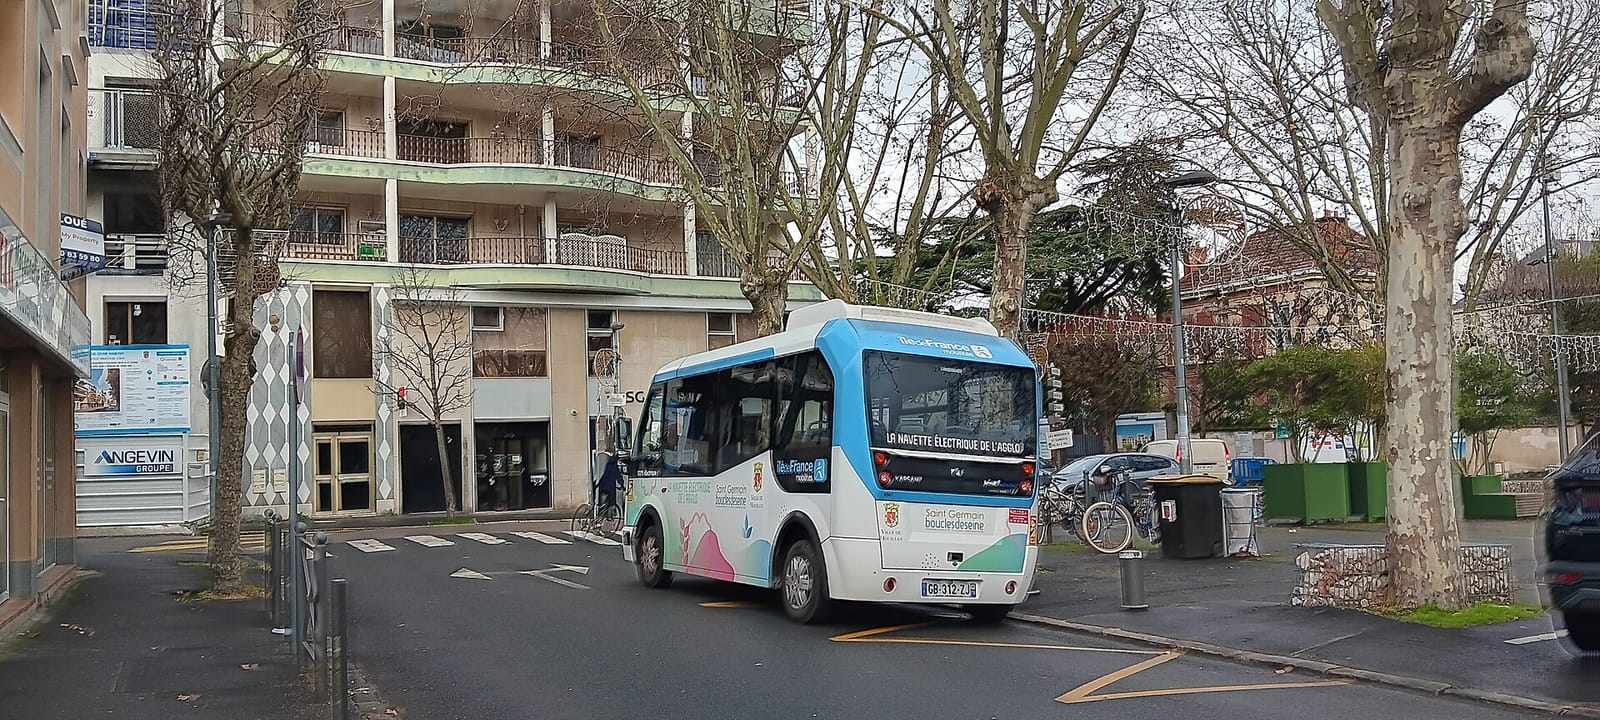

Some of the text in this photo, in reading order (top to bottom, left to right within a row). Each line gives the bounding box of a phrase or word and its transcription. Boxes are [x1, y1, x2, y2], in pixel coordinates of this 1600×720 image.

[61, 216, 87, 228] OUÉ
[73, 234, 98, 245] Property
[626, 391, 645, 403] SG
[887, 433, 896, 443] LA
[898, 433, 932, 447] NAVETTE
[934, 434, 979, 450] ÉLECTRIQUE
[980, 441, 990, 451] DE
[94, 450, 174, 464] ANGEVIN
[925, 508, 985, 520] Saint Germain
[925, 518, 985, 531] bouclesdeseine
